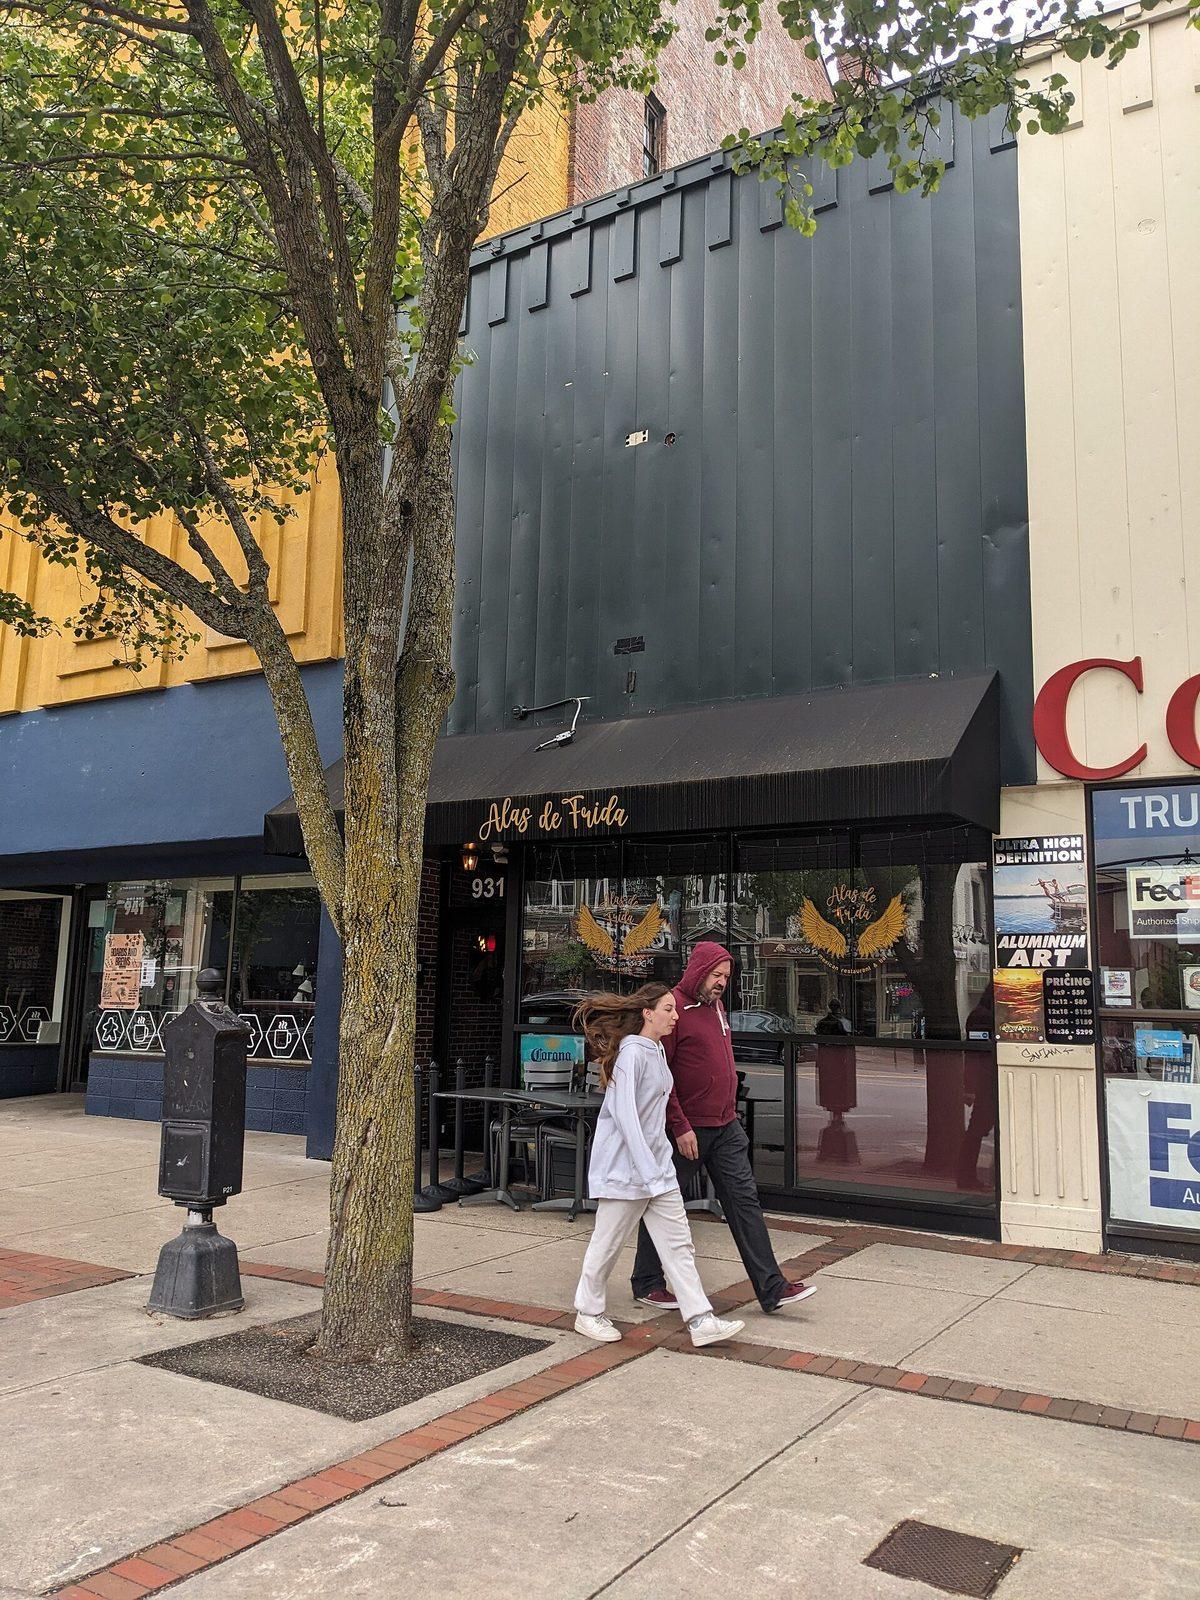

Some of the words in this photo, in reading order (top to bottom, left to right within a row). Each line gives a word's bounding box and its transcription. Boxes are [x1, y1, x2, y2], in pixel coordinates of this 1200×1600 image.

[479, 797, 532, 840] Alas
[538, 800, 562, 831] de
[561, 795, 629, 829] Frida
[1120, 793, 1199, 829] TRU
[995, 839, 1039, 851] ULTRA
[1043, 837, 1082, 849] HIGH
[996, 850, 1083, 864] DEFINITION
[471, 877, 505, 899] 931
[826, 884, 859, 906] Alas
[861, 887, 877, 903] de
[124, 899, 145, 915] 941
[1136, 917, 1180, 926] Authorized
[997, 935, 1086, 949] ALUMINUM
[1007, 949, 1072, 967] ART
[1046, 977, 1092, 986] PRICING
[530, 1047, 572, 1062] Corona
[1147, 1101, 1200, 1175] F
[222, 1186, 233, 1194] P21
